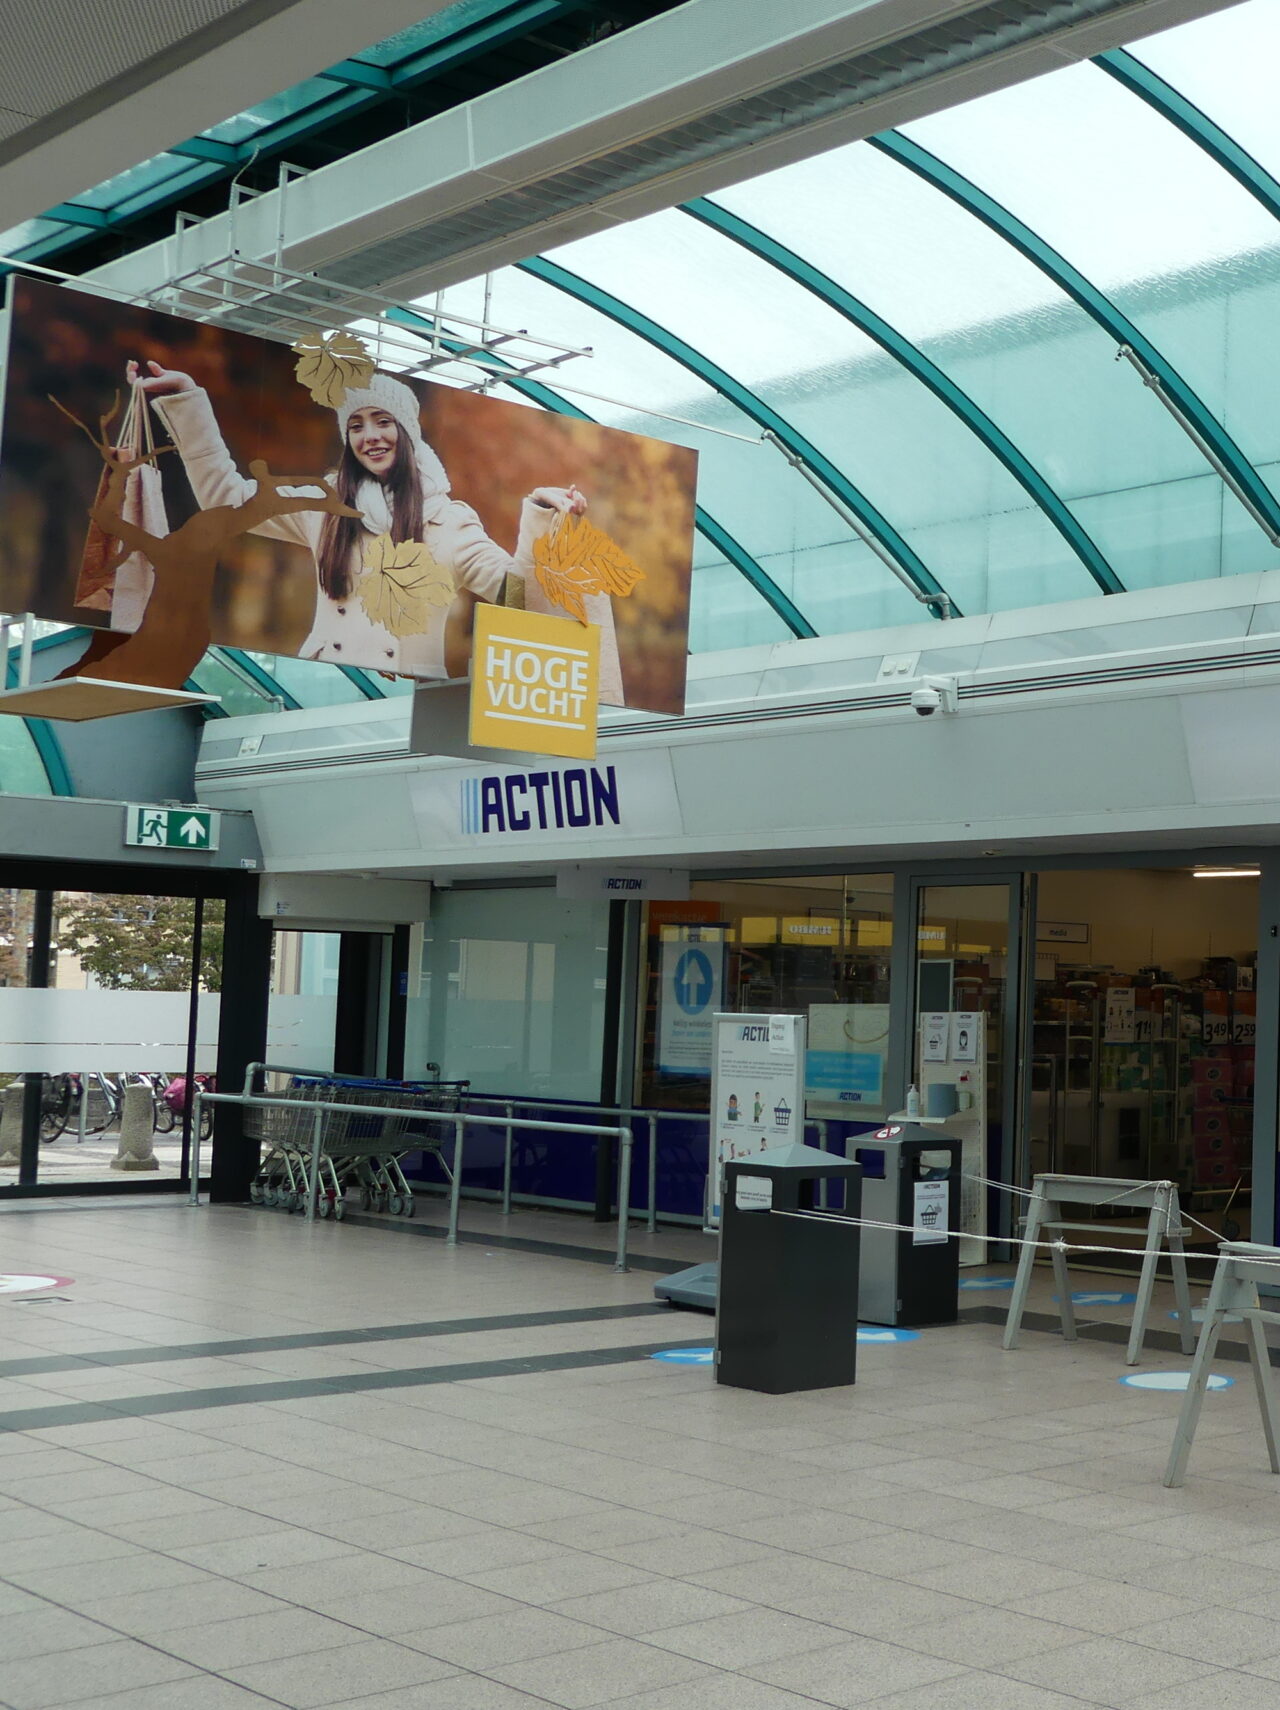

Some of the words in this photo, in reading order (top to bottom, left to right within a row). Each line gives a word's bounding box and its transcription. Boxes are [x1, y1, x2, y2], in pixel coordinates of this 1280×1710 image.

[485, 646, 589, 692] HOGE
[485, 679, 587, 718] VUCHT
[481, 766, 621, 833] ACTION
[607, 878, 642, 889] ACTION
[741, 1025, 770, 1042] ACTI
[839, 1091, 863, 1101] ACTION
